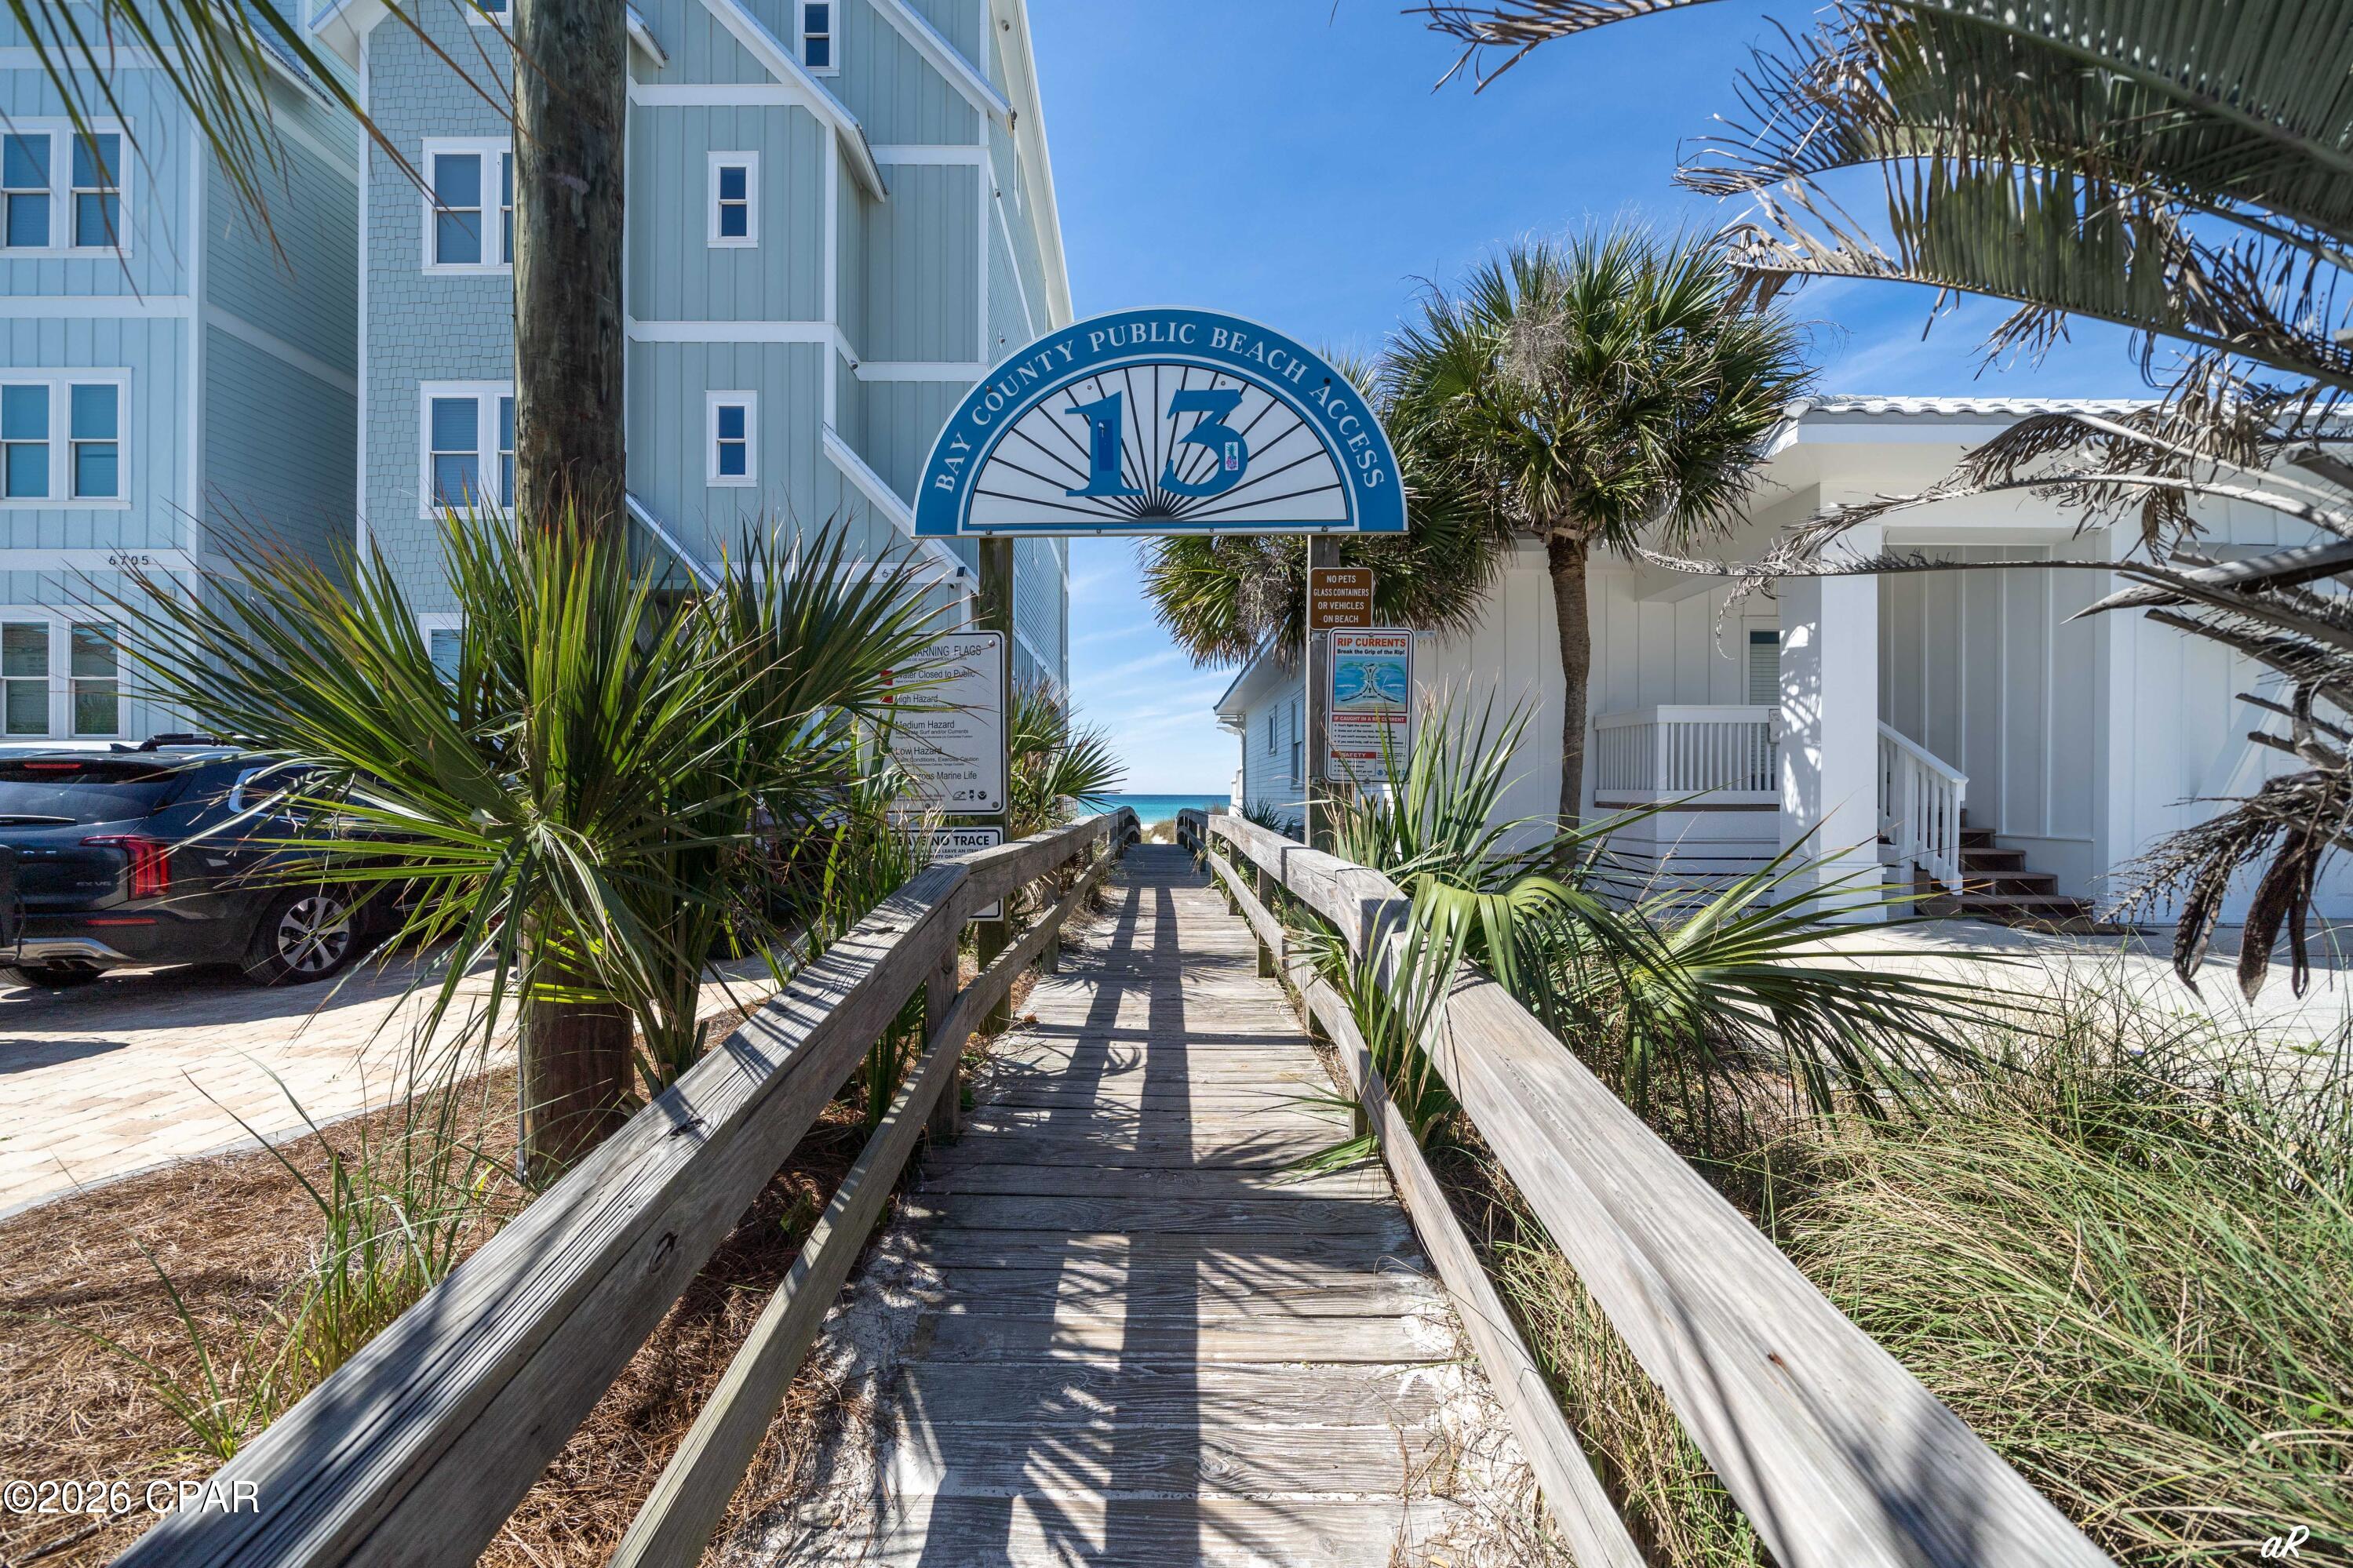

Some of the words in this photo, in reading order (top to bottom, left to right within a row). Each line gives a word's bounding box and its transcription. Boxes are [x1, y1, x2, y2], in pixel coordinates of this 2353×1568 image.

[934, 435, 973, 493] BAY
[972, 339, 1074, 426] COUNTY
[1088, 322, 1197, 353] PUBLIC
[1209, 326, 1308, 384] BEACH
[1309, 384, 1385, 489] ACCESS
[1065, 389, 1249, 497] 13
[109, 555, 149, 566] 6705
[1337, 638, 1353, 646] RIP
[1356, 638, 1406, 647] CURRENTS
[954, 645, 982, 656] FLAGS
[918, 669, 943, 678] Closed
[954, 669, 975, 678] Public
[913, 694, 938, 703] Hazard
[914, 746, 942, 755] Hazard
[937, 771, 961, 780] Marine
[964, 770, 977, 780] Life
[932, 836, 950, 846] NO
[954, 836, 989, 846] TRACE
